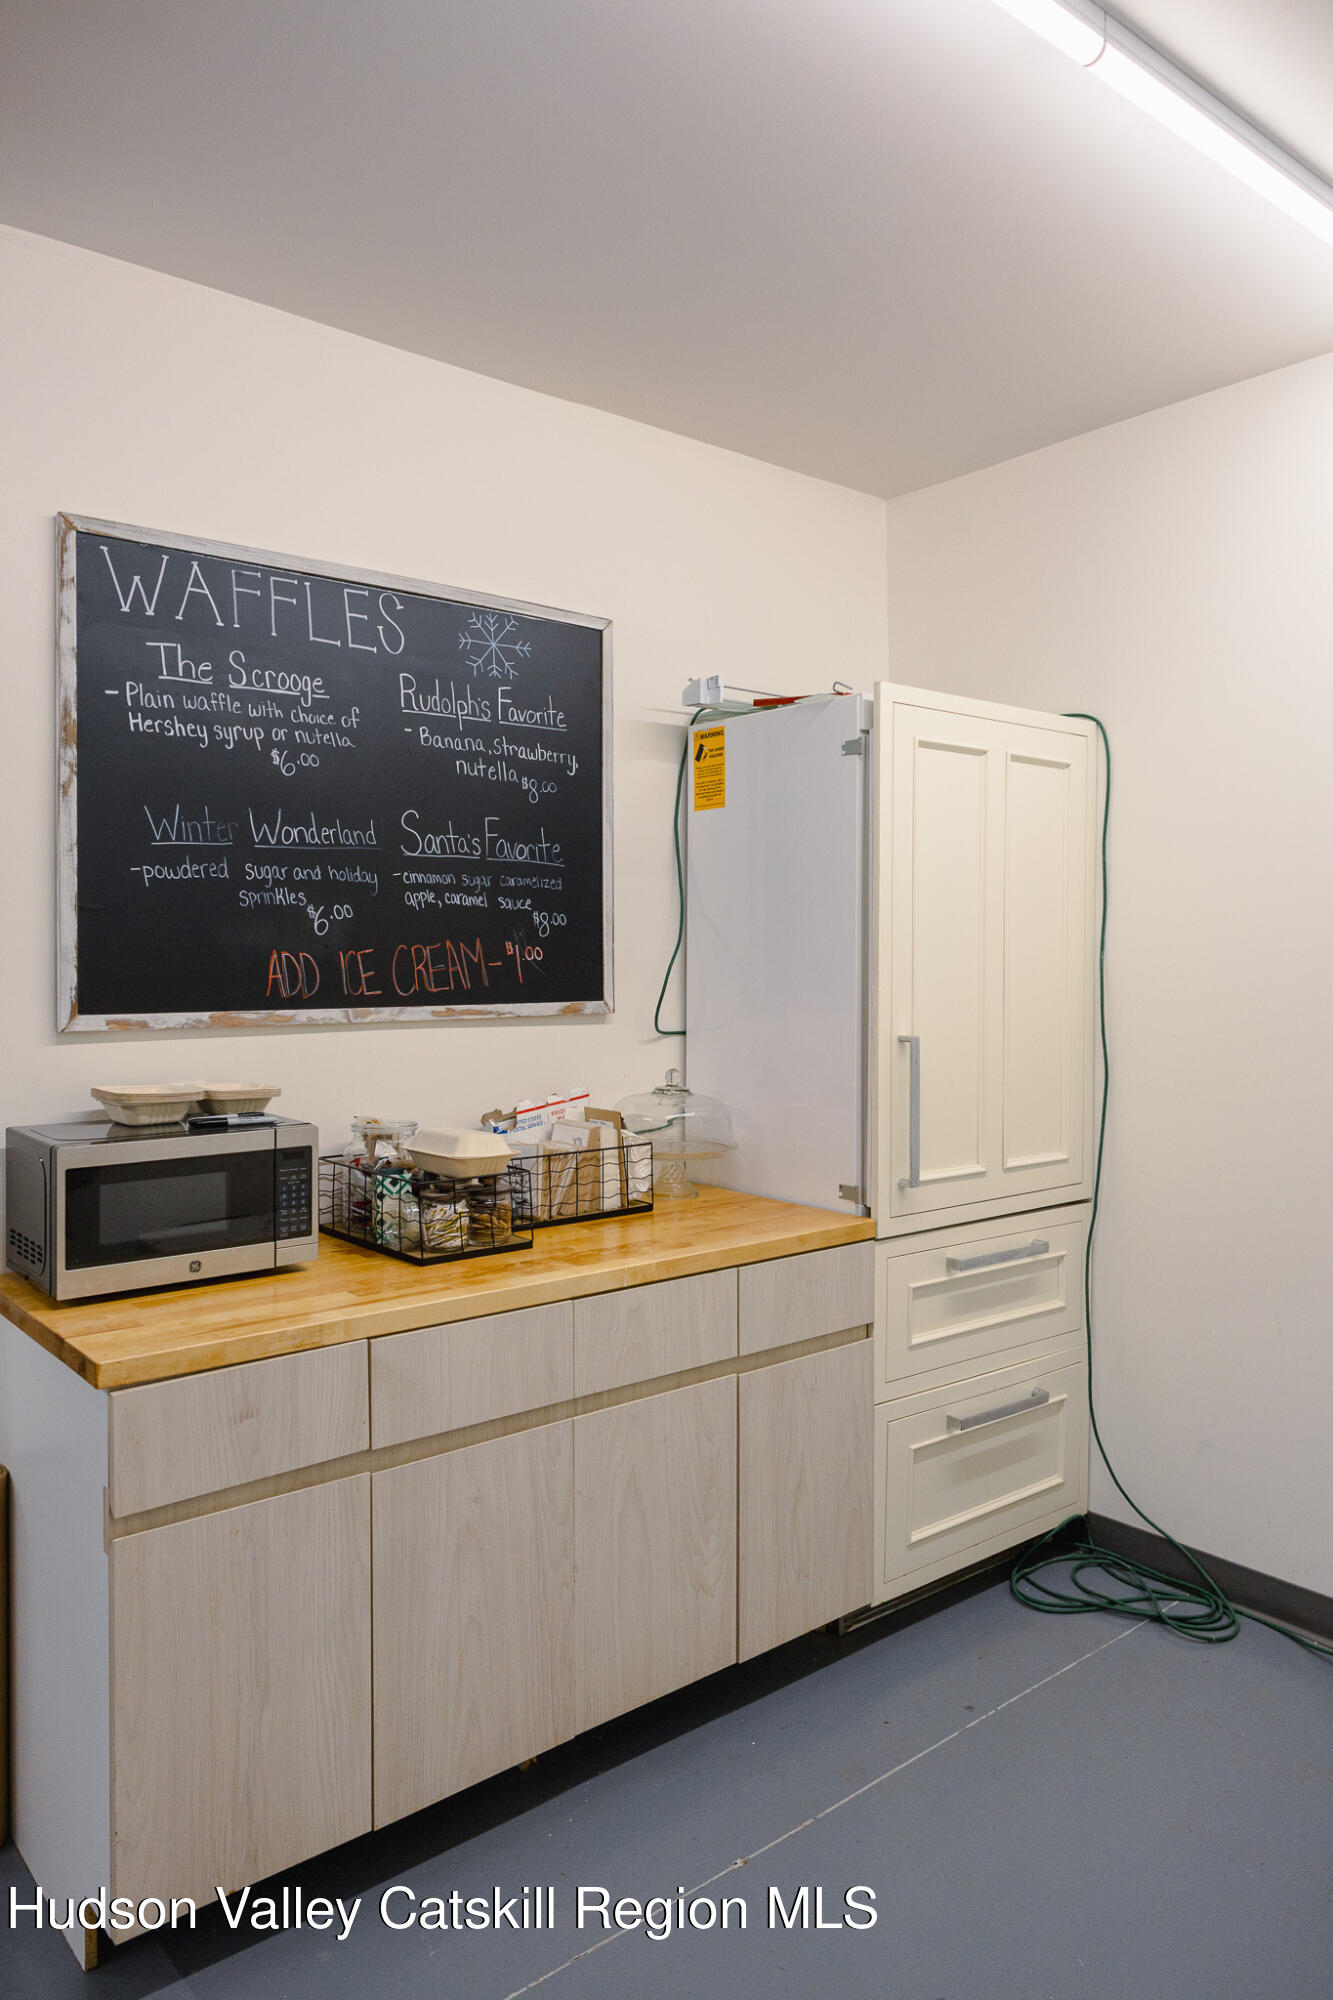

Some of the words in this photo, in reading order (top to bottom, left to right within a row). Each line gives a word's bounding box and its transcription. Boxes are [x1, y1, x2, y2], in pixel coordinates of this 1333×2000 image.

[100, 546, 404, 655] WAFFLES
[146, 642, 212, 683] The
[229, 650, 328, 707] Scrooge
[126, 681, 176, 709] Plain
[183, 692, 242, 714] waffle
[248, 699, 284, 719] with
[290, 705, 336, 726] choice
[341, 706, 361, 728] of
[400, 673, 491, 731] Rudolph's
[498, 686, 567, 731] Favorite
[129, 711, 207, 748] Hershey
[213, 724, 265, 750] syrup
[271, 728, 288, 741] or
[295, 729, 356, 748] nutella
[700, 729, 724, 739] WARNING
[270, 748, 320, 776] $6.00
[456, 758, 518, 783] nutella
[521, 776, 557, 803] $8.00
[144, 803, 239, 843] Winter
[248, 807, 379, 848] Wonderland
[400, 809, 482, 858] Santa's
[484, 817, 565, 865] Favorite
[293, 865, 322, 881] and
[328, 865, 379, 896] holiday
[462, 874, 493, 893] sugar
[500, 874, 563, 890] caramelized
[404, 890, 442, 910] apple,
[444, 891, 488, 907] caramel
[498, 896, 532, 910] sauce
[307, 904, 354, 935] $6.00
[533, 911, 567, 937] $8.00
[266, 949, 320, 999] ADD
[339, 949, 382, 996] ICE
[392, 937, 489, 996] CREAM
